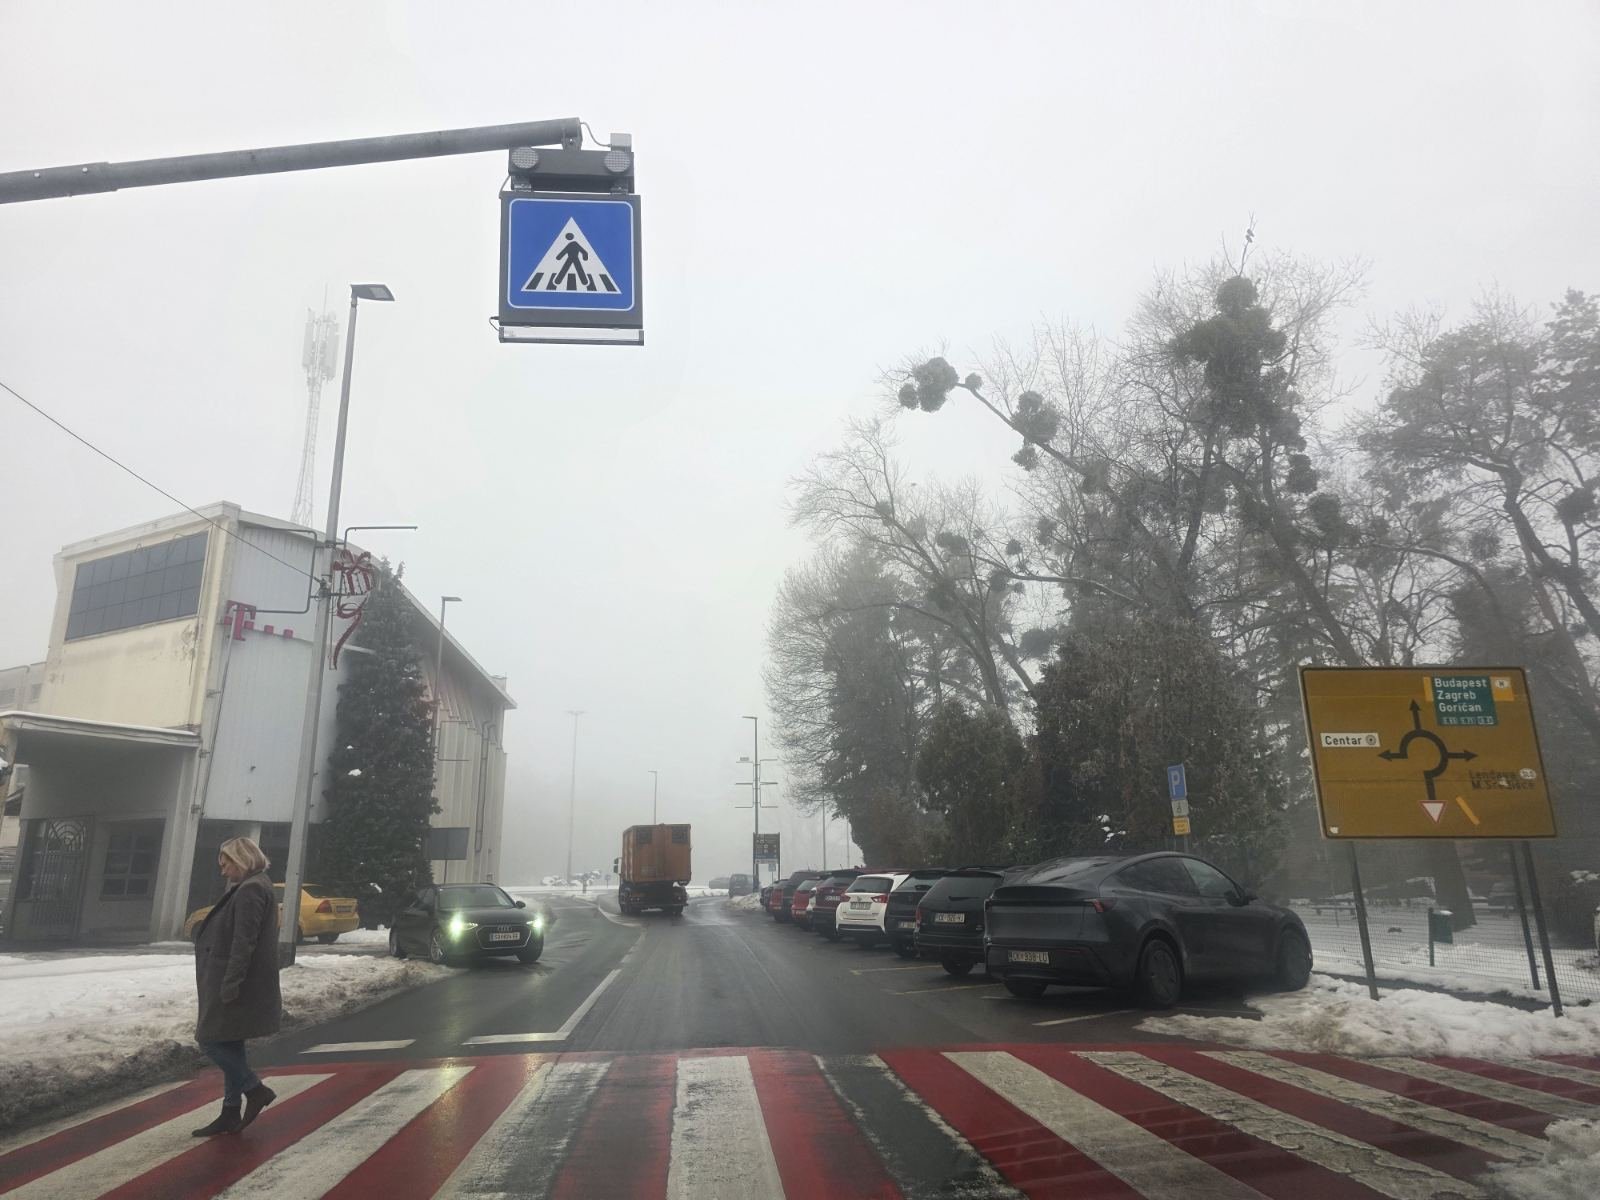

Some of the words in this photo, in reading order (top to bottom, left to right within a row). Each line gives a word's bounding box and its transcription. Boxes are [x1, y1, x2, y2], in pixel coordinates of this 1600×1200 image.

[1434, 677, 1487, 690] Budapest
[1437, 690, 1477, 703] Zagreb
[1325, 735, 1362, 746] Centar
[1171, 771, 1180, 796] P
